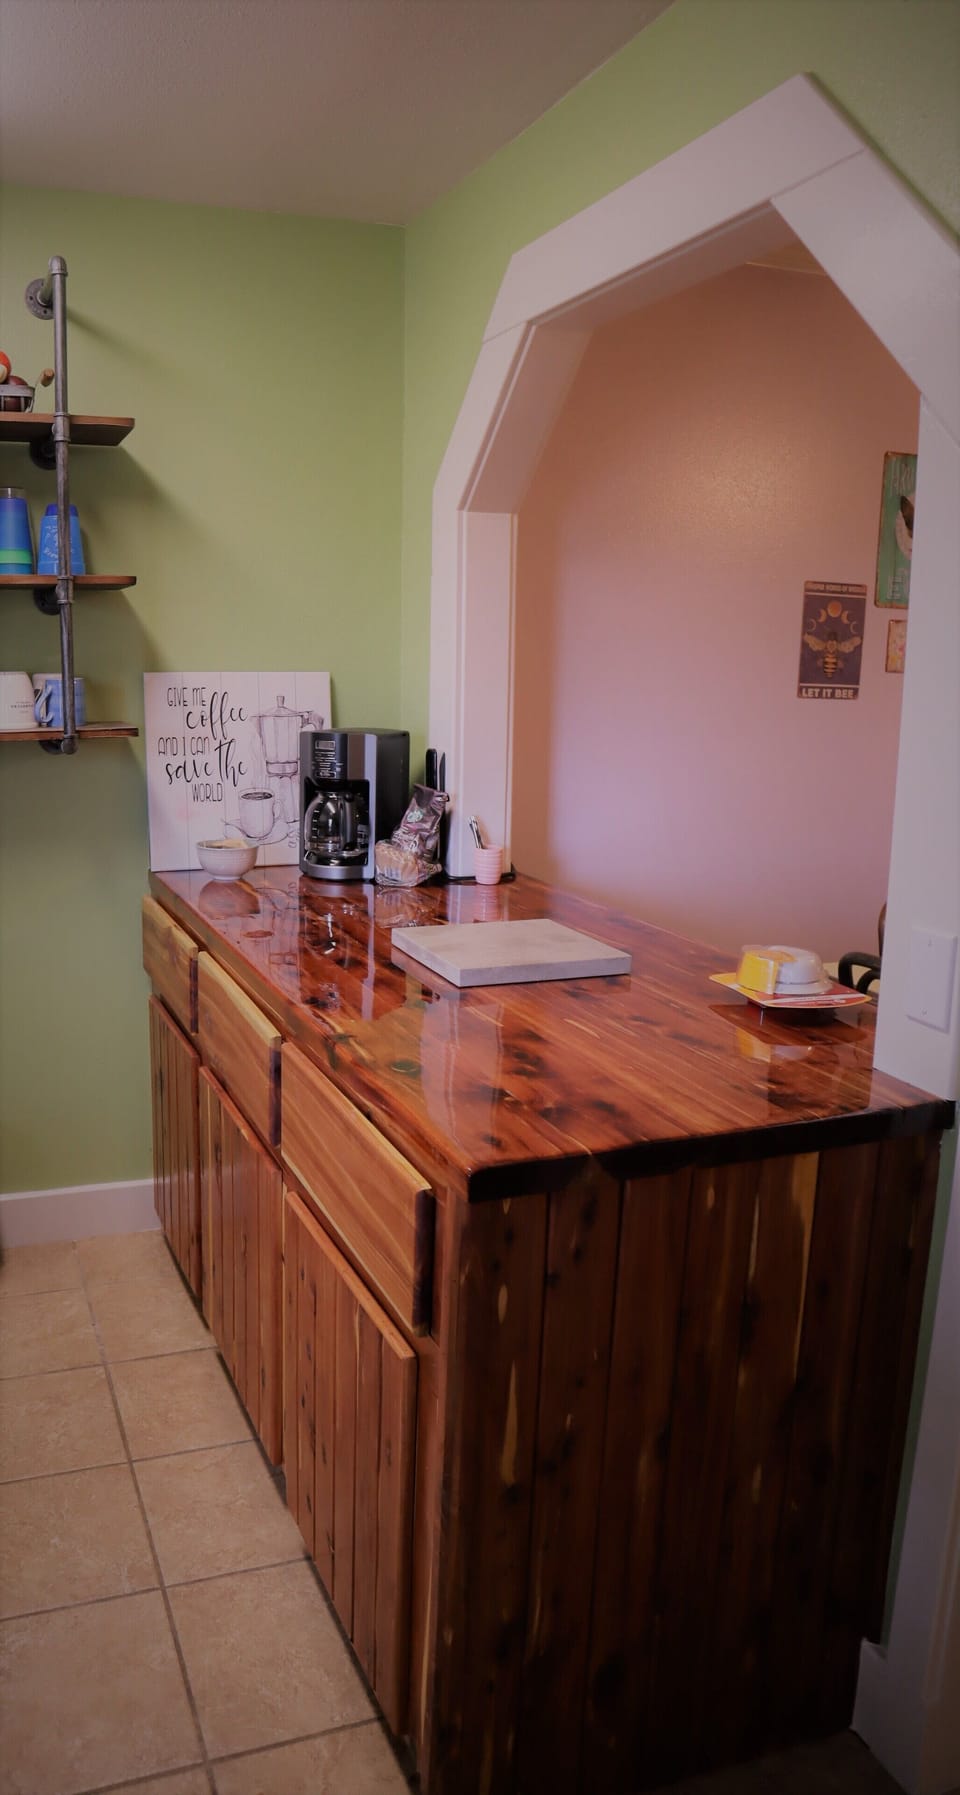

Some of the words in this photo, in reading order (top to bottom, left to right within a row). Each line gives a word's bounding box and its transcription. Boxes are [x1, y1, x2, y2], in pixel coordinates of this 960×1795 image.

[166, 687, 188, 707] GIVE
[192, 687, 207, 707] ME
[802, 687, 820, 697] LET
[823, 688, 832, 698] IT
[834, 688, 854, 698] BEE
[186, 691, 249, 740] coffee
[157, 736, 178, 756] AND
[191, 736, 210, 756] CAN
[165, 759, 212, 785] save
[214, 738, 248, 787] the
[191, 782, 223, 802] WORLD
